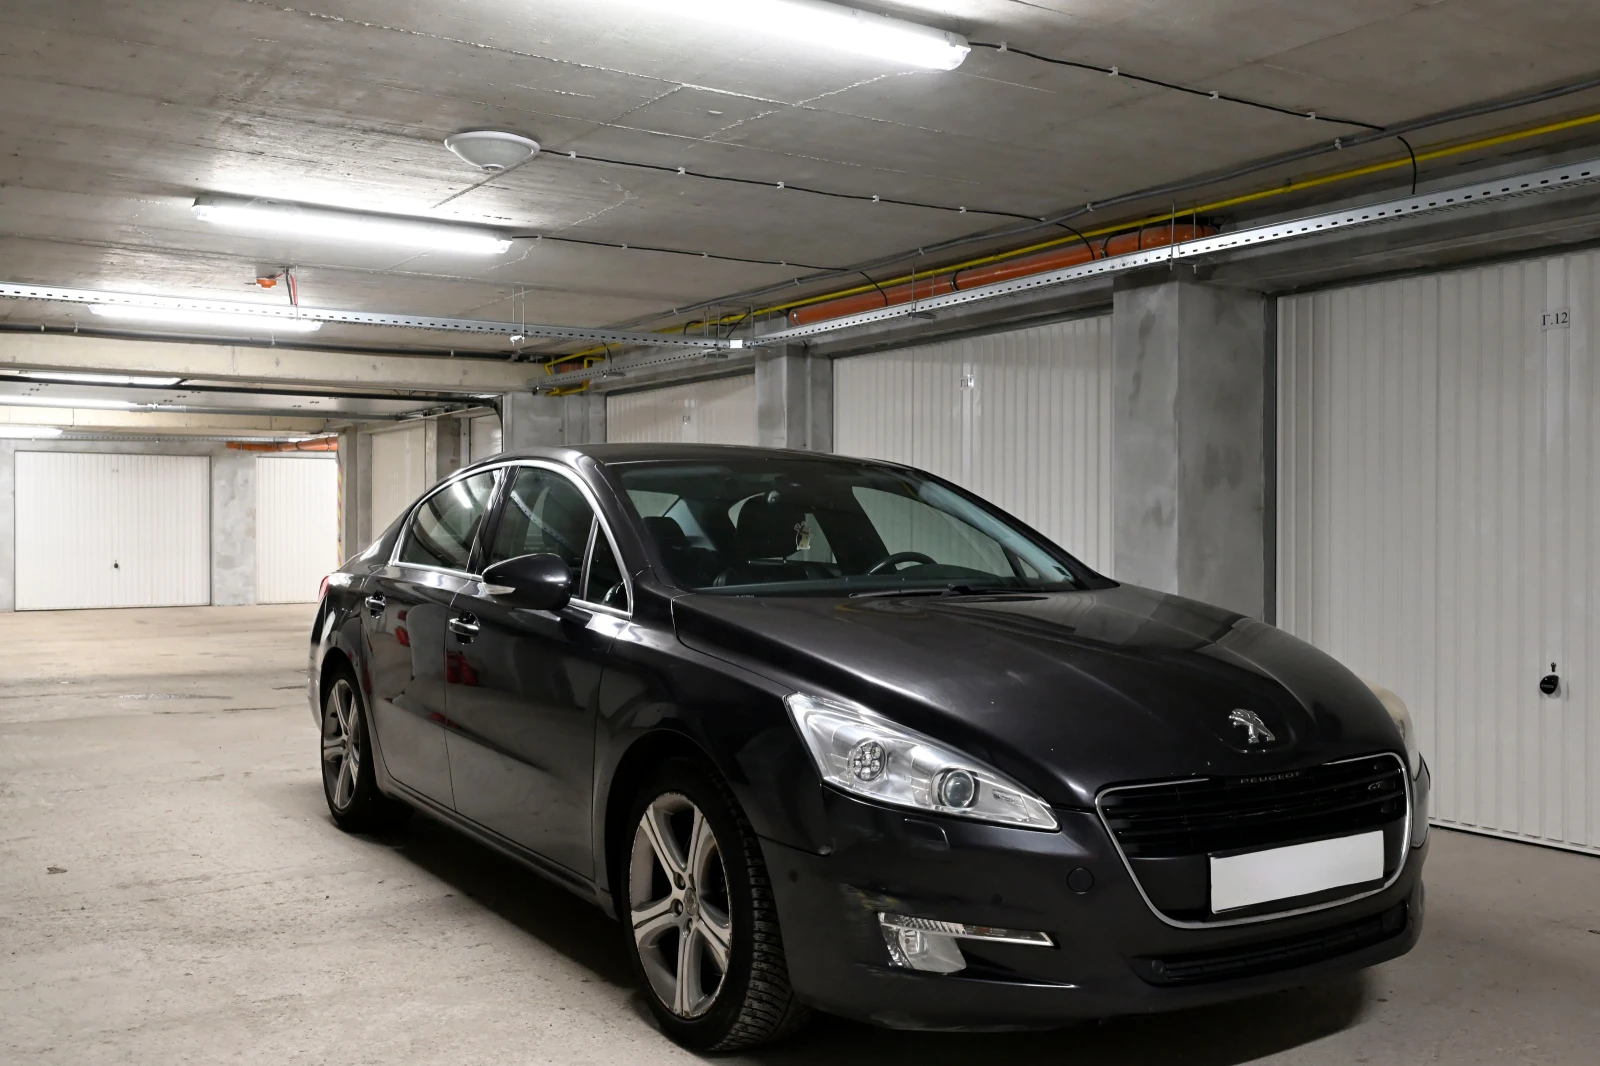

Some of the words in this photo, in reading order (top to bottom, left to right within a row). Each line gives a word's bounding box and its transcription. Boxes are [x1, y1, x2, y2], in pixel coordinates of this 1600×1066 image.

[1542, 311, 1568, 326] Г.12
[1240, 771, 1300, 784] PEUGEOT
[1367, 780, 1384, 791] GT
